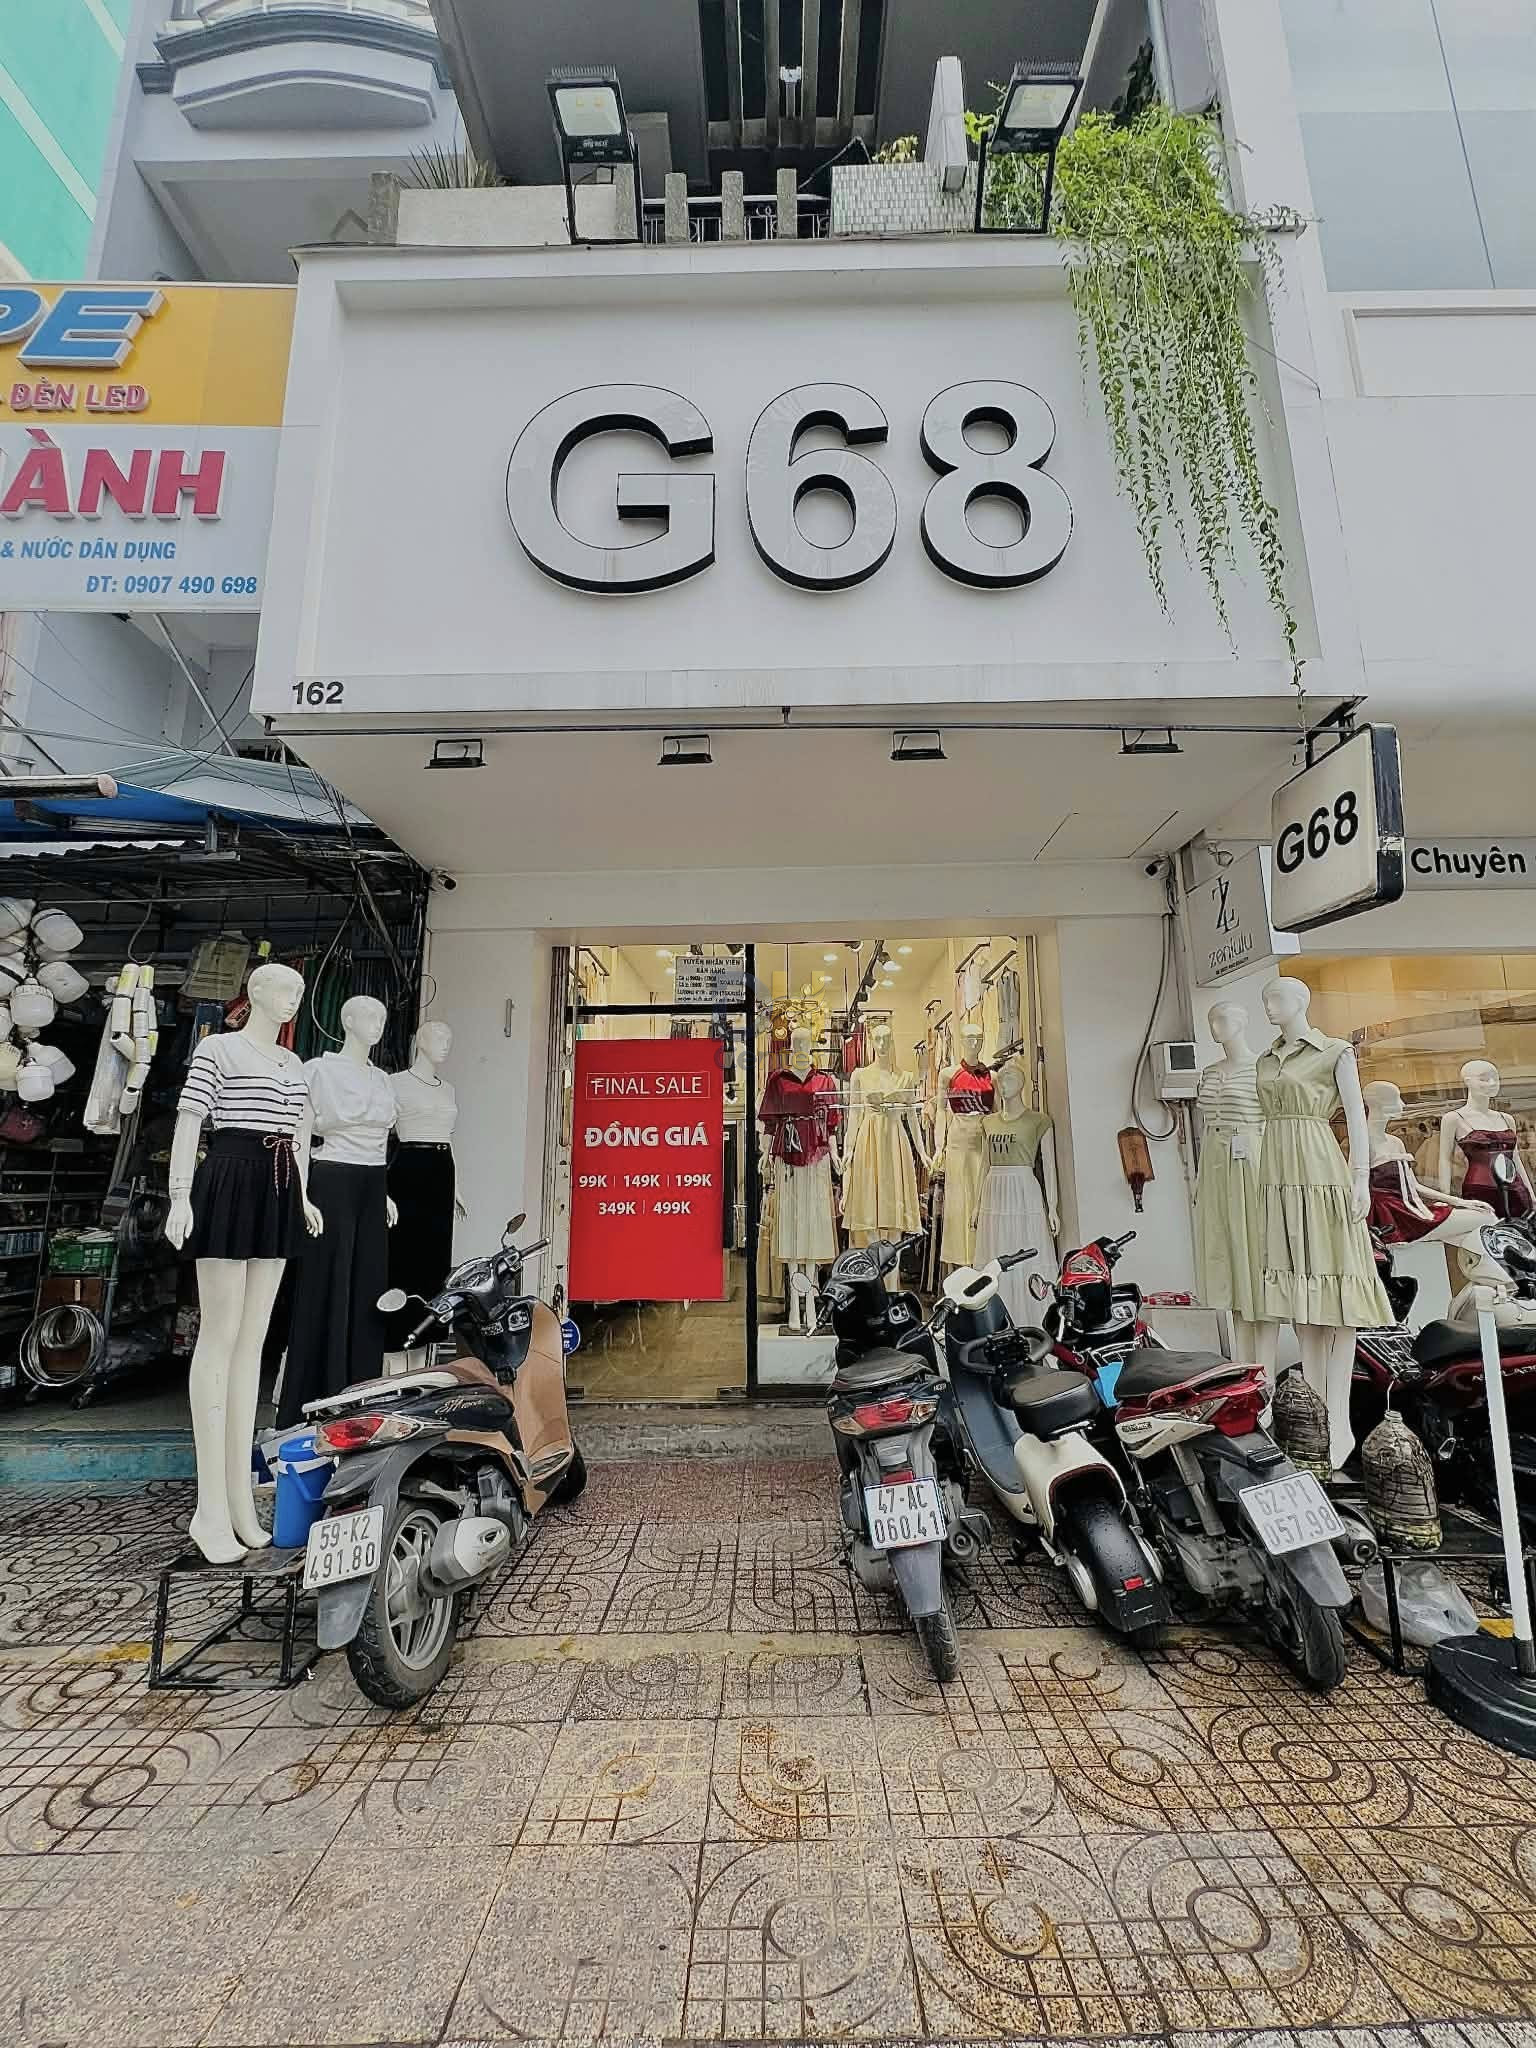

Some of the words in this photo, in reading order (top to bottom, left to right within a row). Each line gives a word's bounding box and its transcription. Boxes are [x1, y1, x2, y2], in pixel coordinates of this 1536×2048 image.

[86, 384, 149, 412] LED
[505, 379, 1074, 595] G68
[1, 541, 14, 558] &
[21, 536, 73, 558] NƯỚC
[79, 538, 117, 559] DÂN
[124, 542, 176, 563] DỤNG
[86, 575, 117, 593] ĐT:
[124, 575, 173, 593] 0907
[179, 576, 215, 594] 490
[221, 576, 257, 594] 698
[292, 681, 344, 705] 162
[1276, 791, 1359, 874] G68
[1411, 846, 1527, 878] Chuyên
[591, 1076, 650, 1095] FINAL
[655, 1076, 702, 1094] SALE
[584, 1121, 659, 1147] ĐỒNG
[664, 1122, 709, 1146] GIÁ
[579, 1175, 608, 1188] 99K
[623, 1175, 661, 1188] 149K
[675, 1173, 712, 1187] 199K
[598, 1201, 637, 1215] 349K
[653, 1201, 691, 1214] 499K
[878, 1484, 928, 1513] 47-AC
[319, 1514, 371, 1550] 59-K2
[874, 1510, 940, 1543] 060.41
[309, 1540, 376, 1581] 491.80
